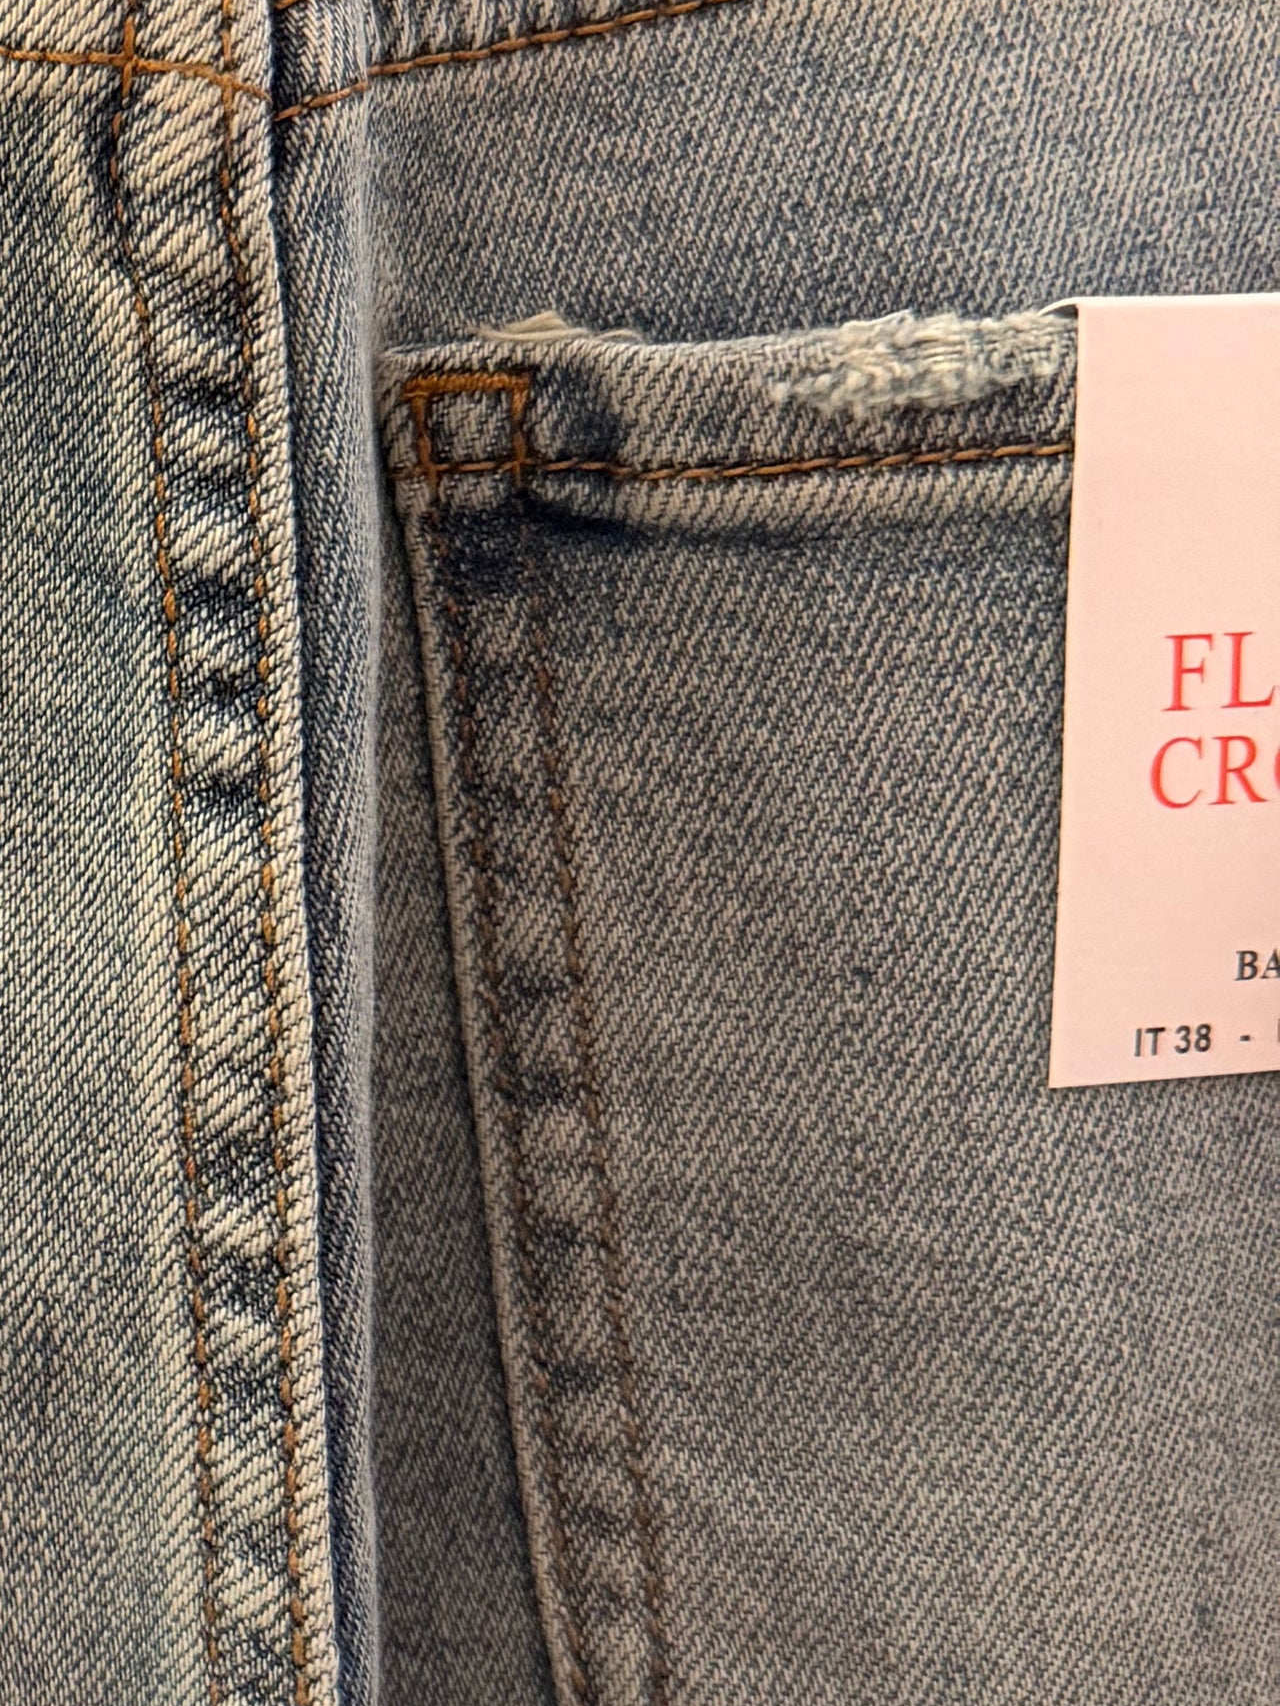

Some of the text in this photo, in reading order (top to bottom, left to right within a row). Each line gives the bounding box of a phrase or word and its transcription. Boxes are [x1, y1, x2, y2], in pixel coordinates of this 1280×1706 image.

[1149, 734, 1280, 810] CR
[1134, 1026, 1166, 1057] IT
[1174, 1023, 1212, 1055] 38
